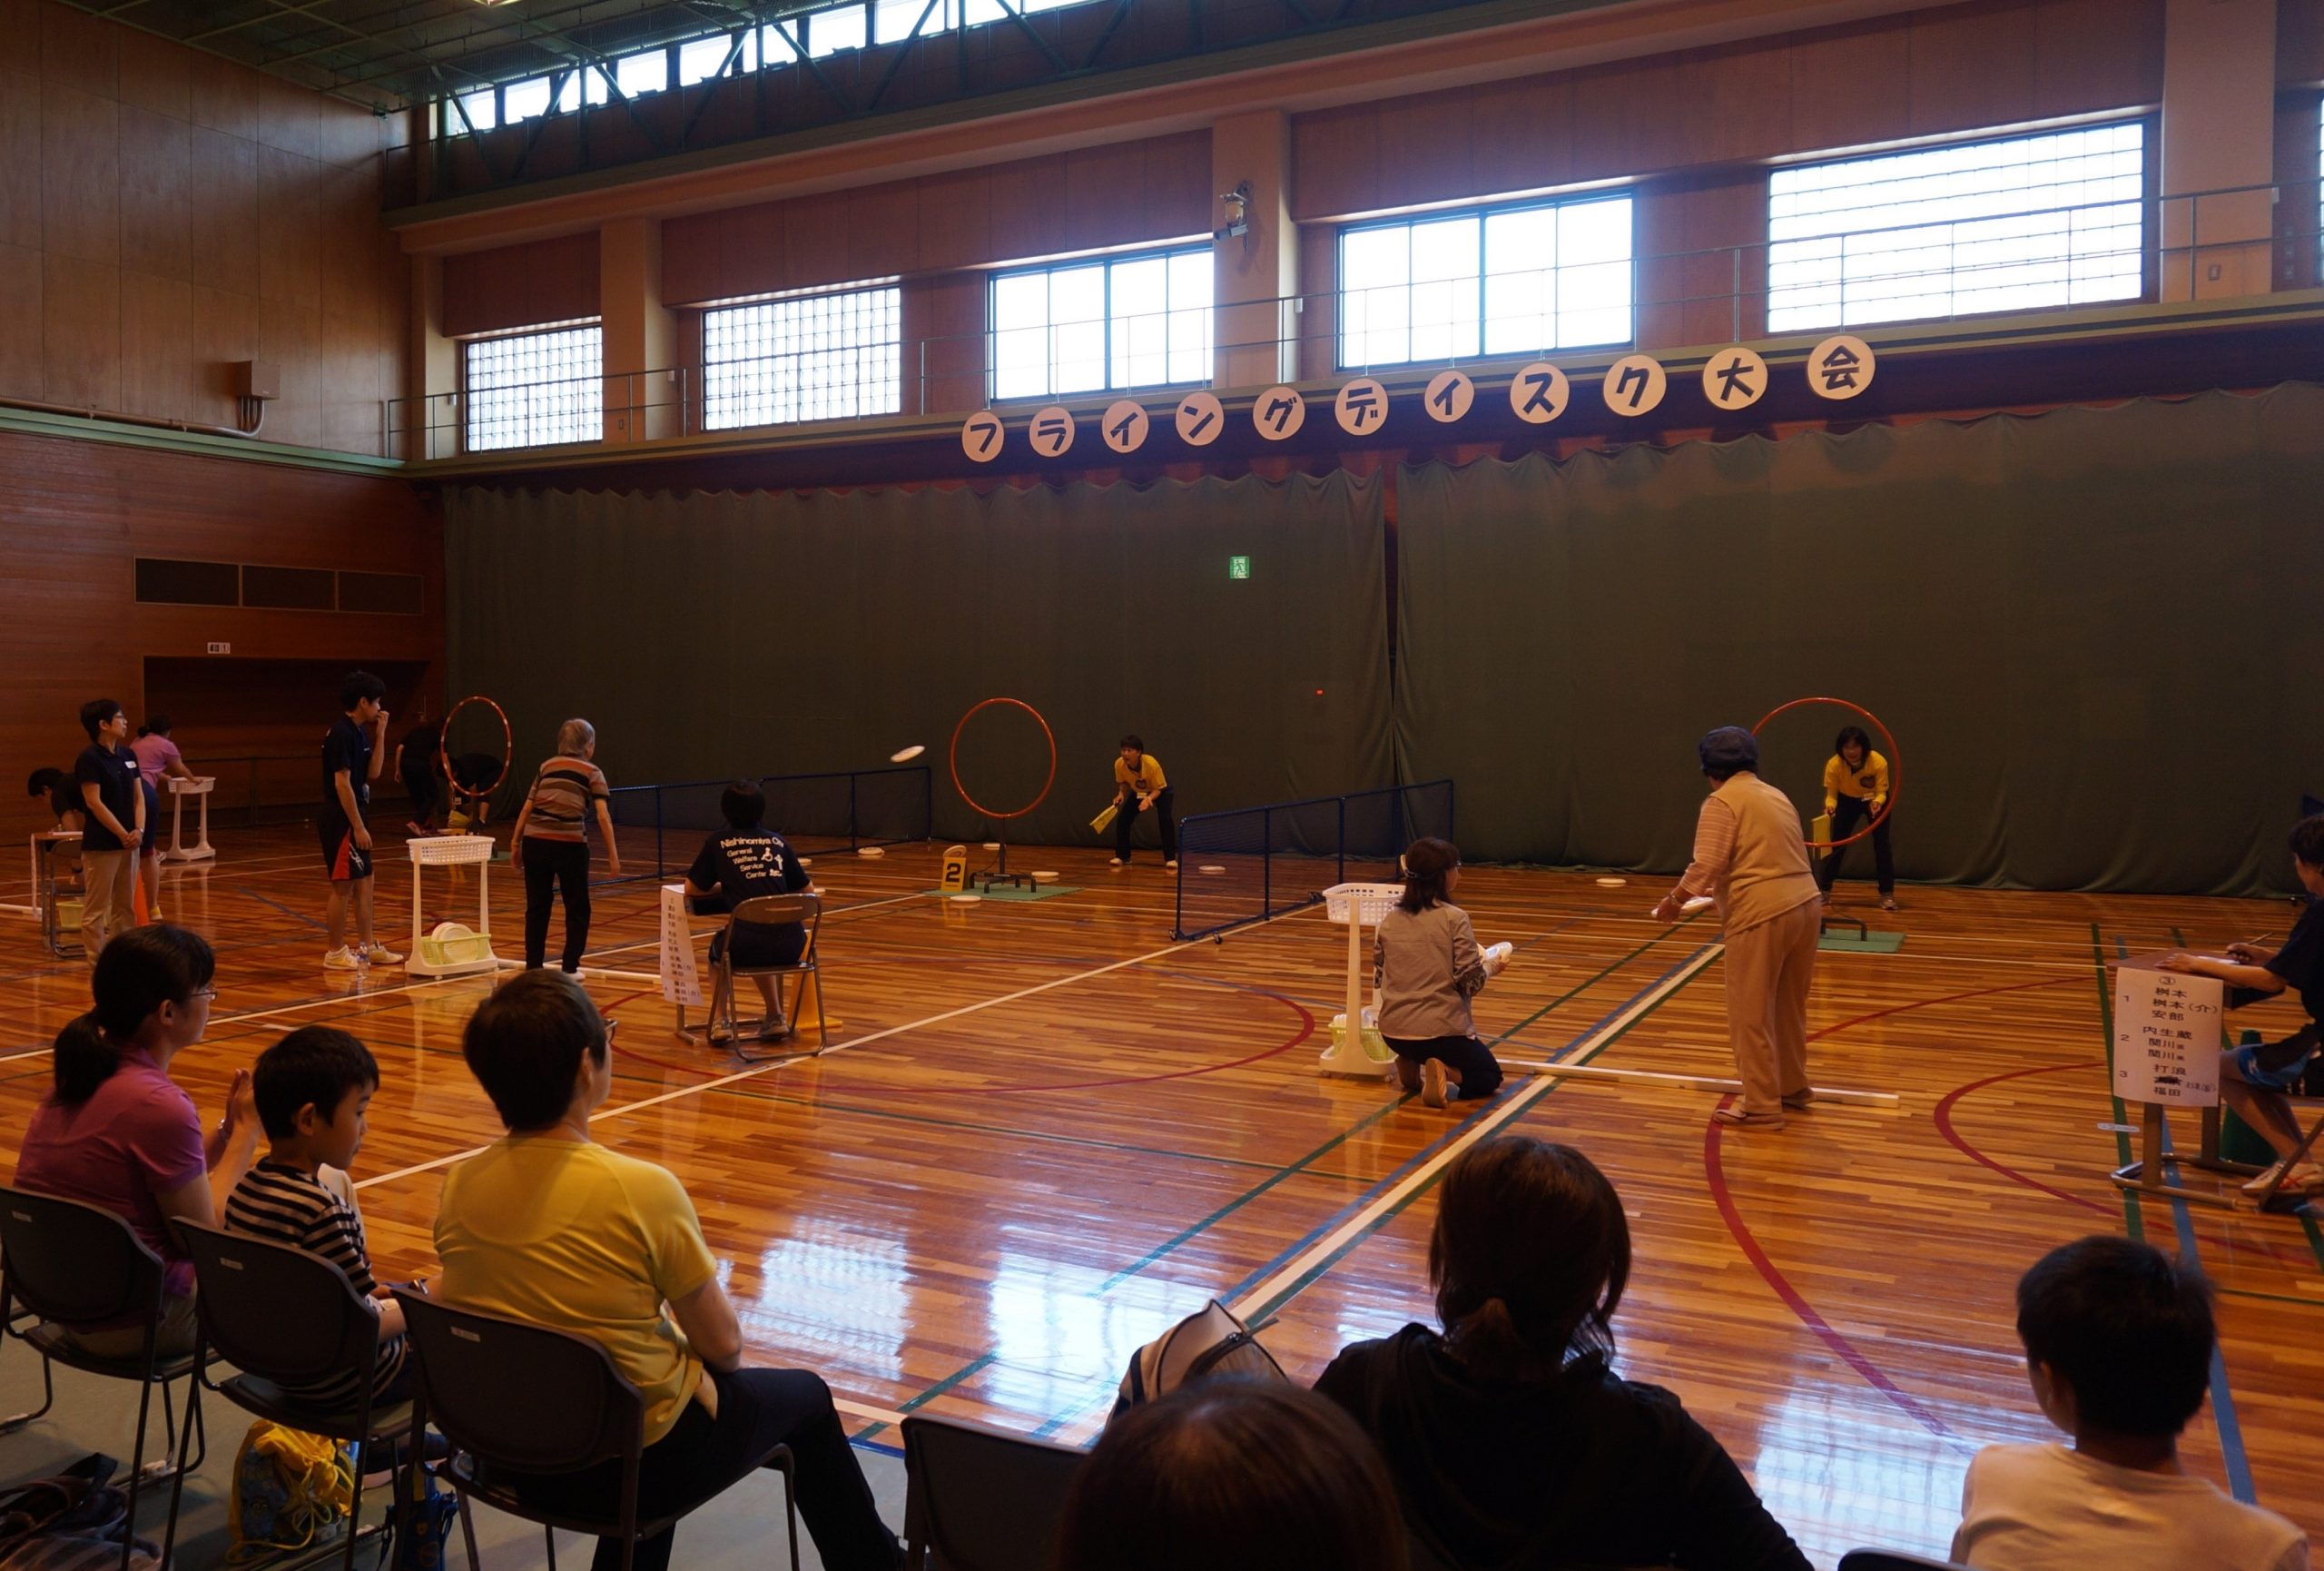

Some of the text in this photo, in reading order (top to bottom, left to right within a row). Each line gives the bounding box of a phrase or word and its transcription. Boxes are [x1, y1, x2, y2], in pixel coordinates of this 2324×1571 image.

[720, 836, 772, 849] Nishinomiya
[727, 847, 753, 857] General
[733, 855, 758, 865] Welfare
[740, 863, 764, 872] Service
[945, 863, 961, 883] 2
[745, 871, 767, 880] Center
[2149, 1038, 2185, 1050] 関川
[2148, 1050, 2185, 1062] 関川
[2153, 1086, 2181, 1097] 福田
